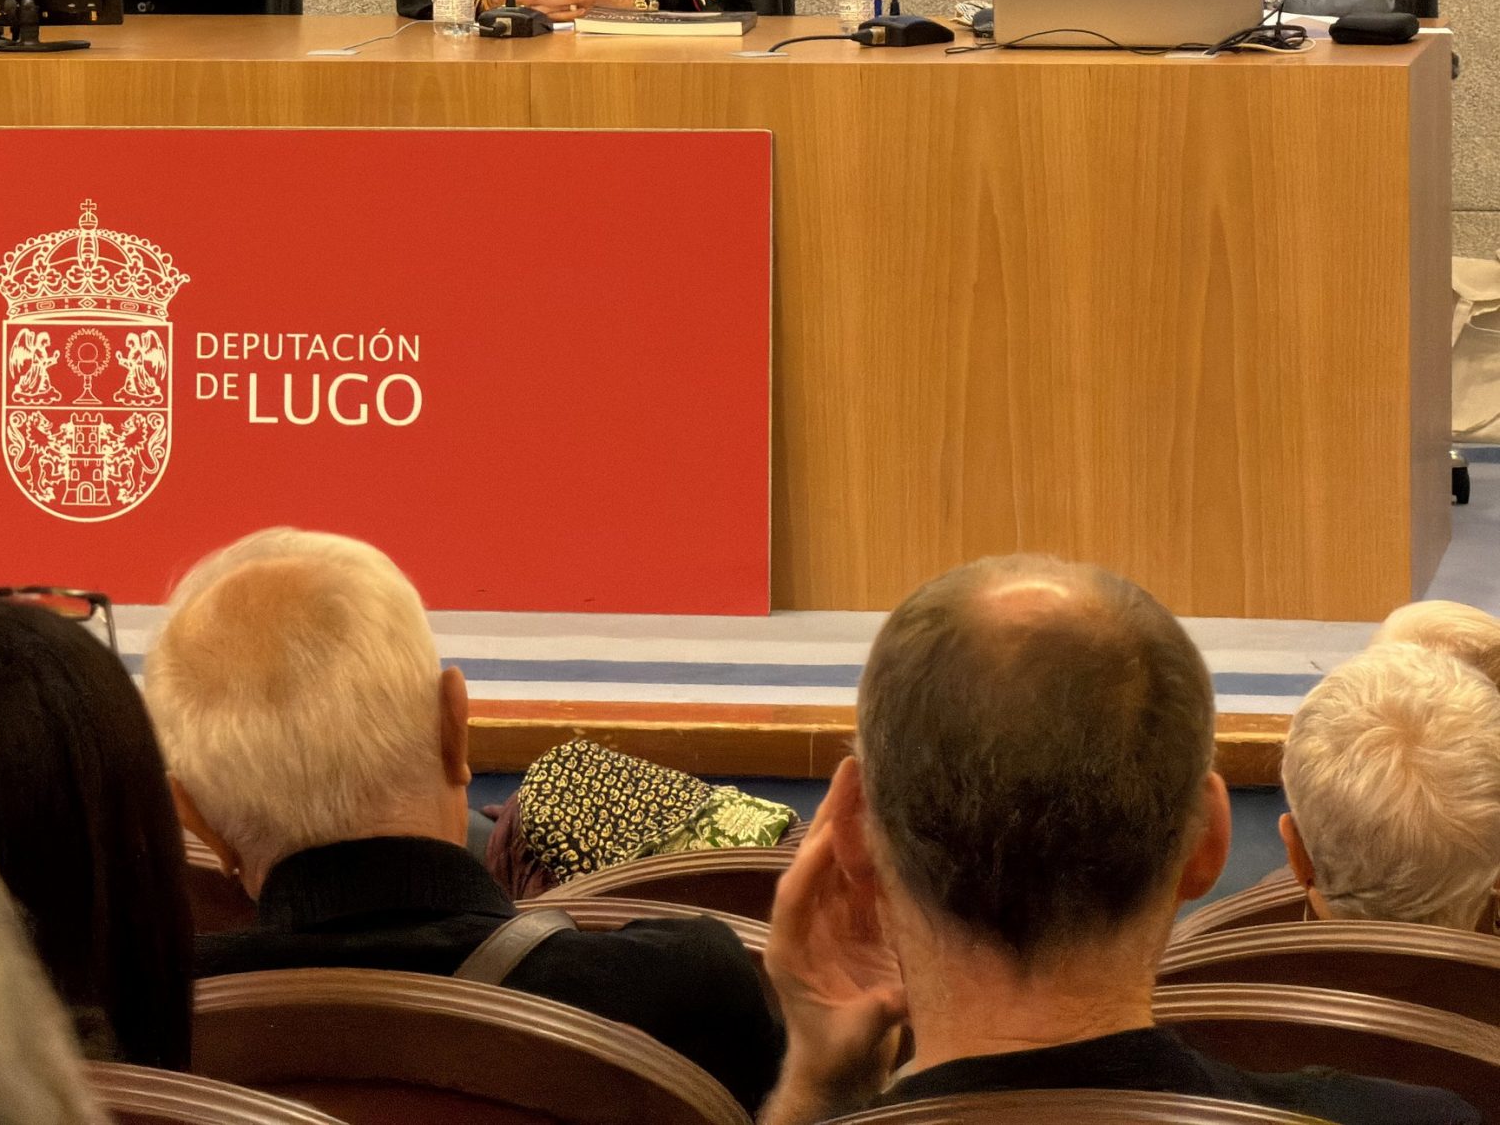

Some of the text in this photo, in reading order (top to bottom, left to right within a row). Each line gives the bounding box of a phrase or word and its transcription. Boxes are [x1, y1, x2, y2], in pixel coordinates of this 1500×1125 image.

[196, 328, 419, 362] DEPUTACIÓN
[196, 373, 422, 426] DE LUGO
